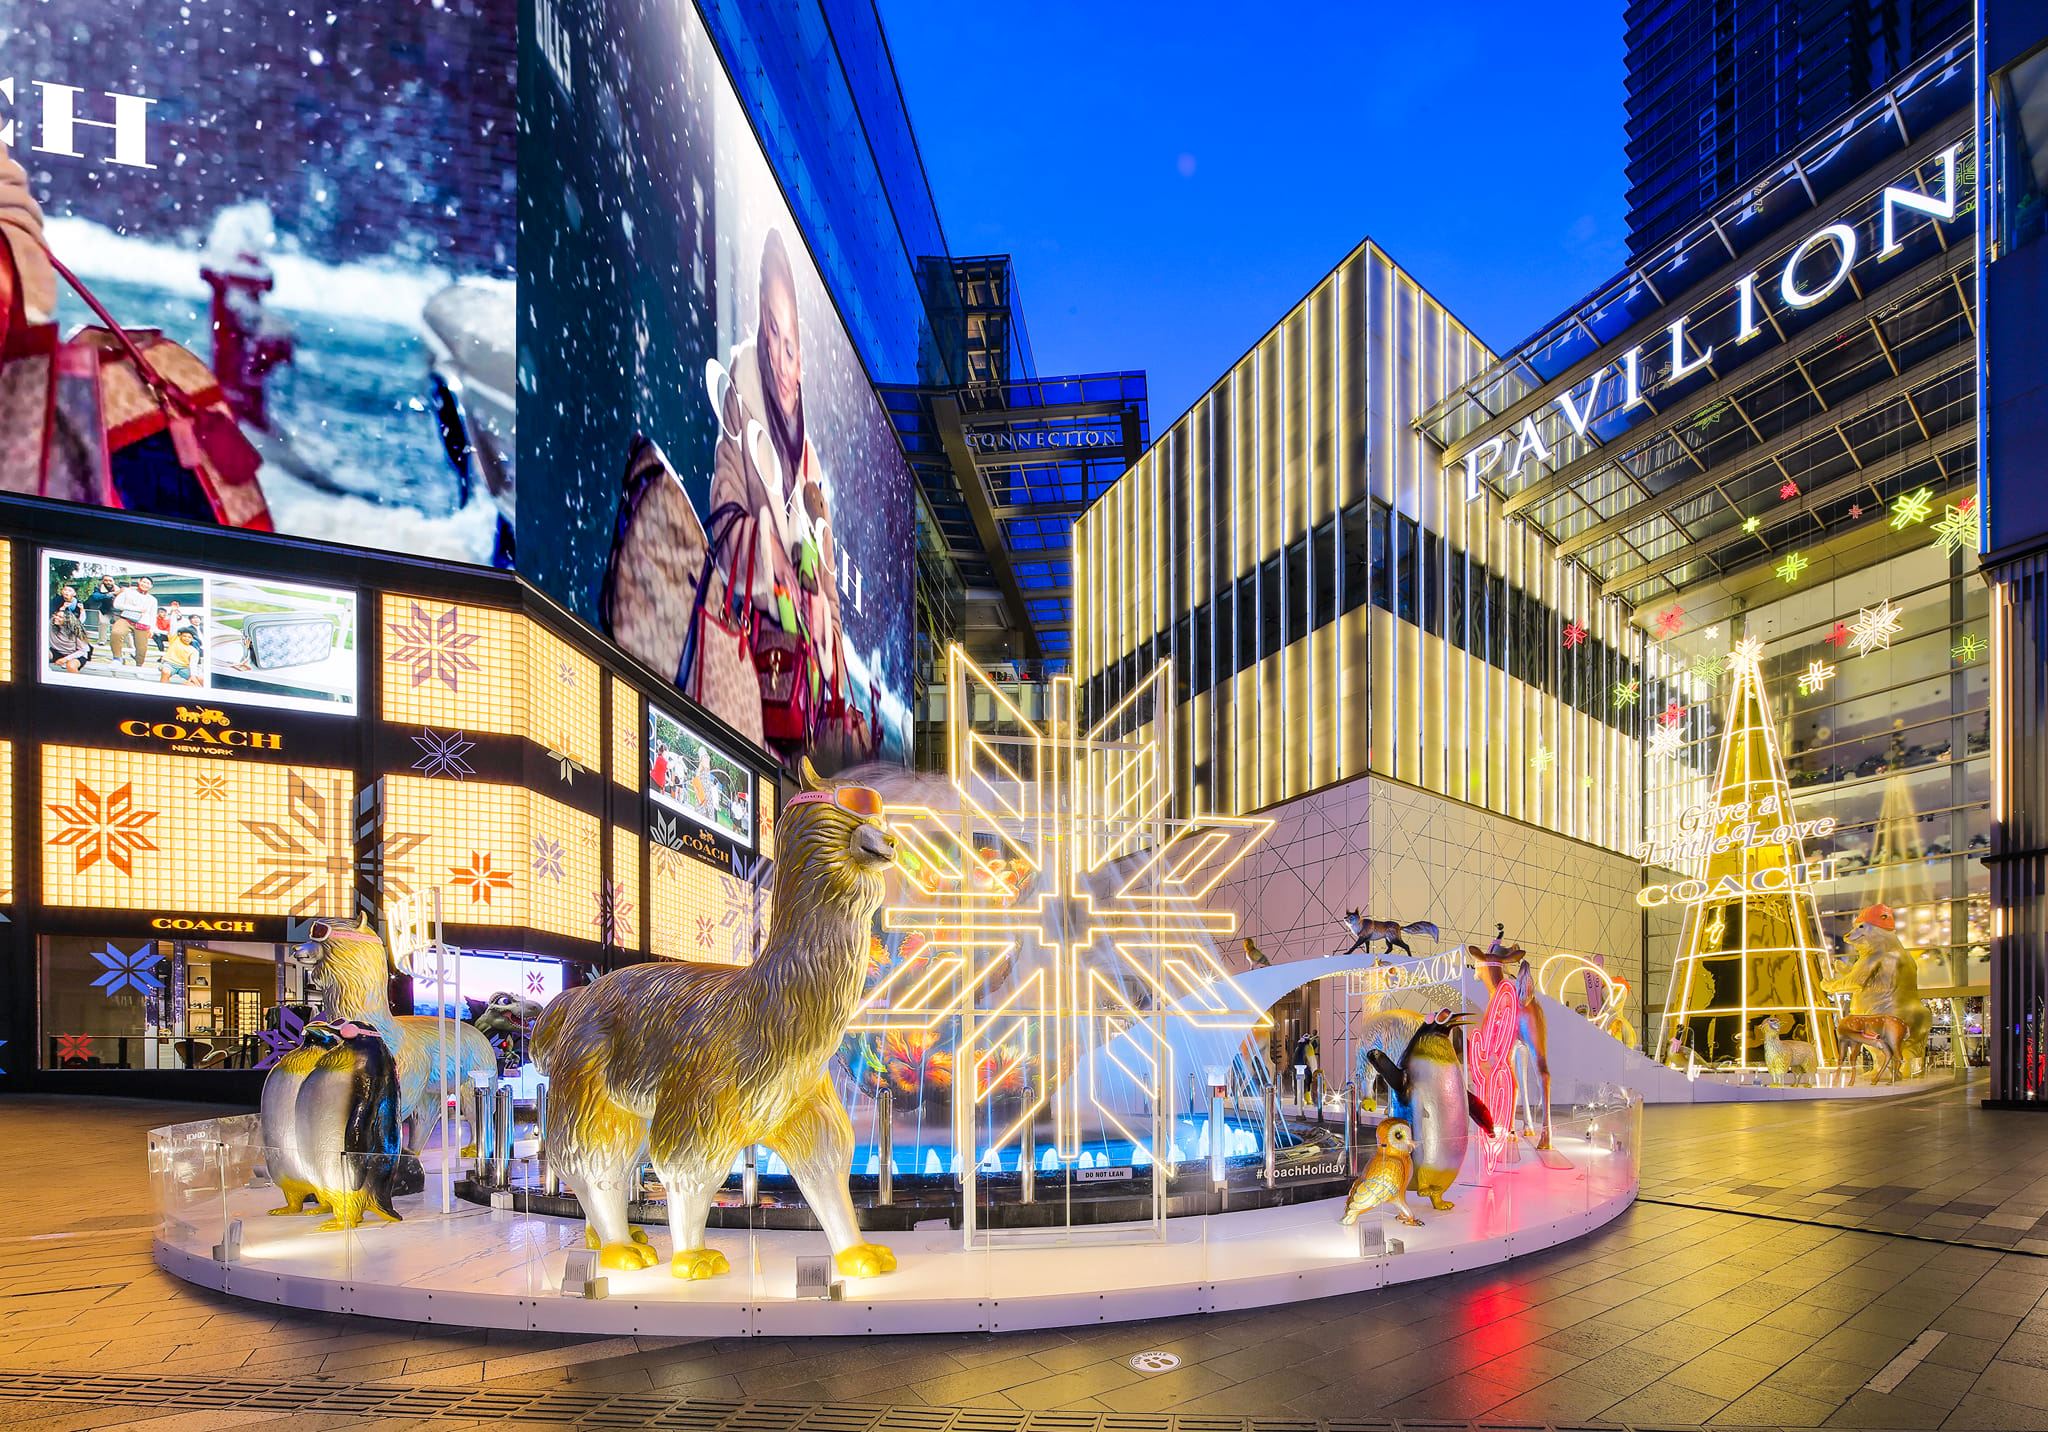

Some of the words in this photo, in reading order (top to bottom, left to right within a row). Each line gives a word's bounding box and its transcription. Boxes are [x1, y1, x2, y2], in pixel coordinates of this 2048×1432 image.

[0, 77, 158, 170] H
[1465, 142, 1963, 503] PAVILION
[966, 430, 1116, 448] CONNECTION
[705, 357, 863, 617] COACH
[119, 720, 283, 750] COACH
[172, 744, 200, 753] NEW
[202, 747, 234, 756] YORK
[1679, 799, 1751, 833] Give
[1757, 794, 1779, 815] a
[682, 834, 729, 863] COACH
[1635, 832, 1731, 866] Little
[1731, 817, 1836, 850] Love
[1636, 859, 1838, 906] COACH
[151, 918, 254, 932] COACH
